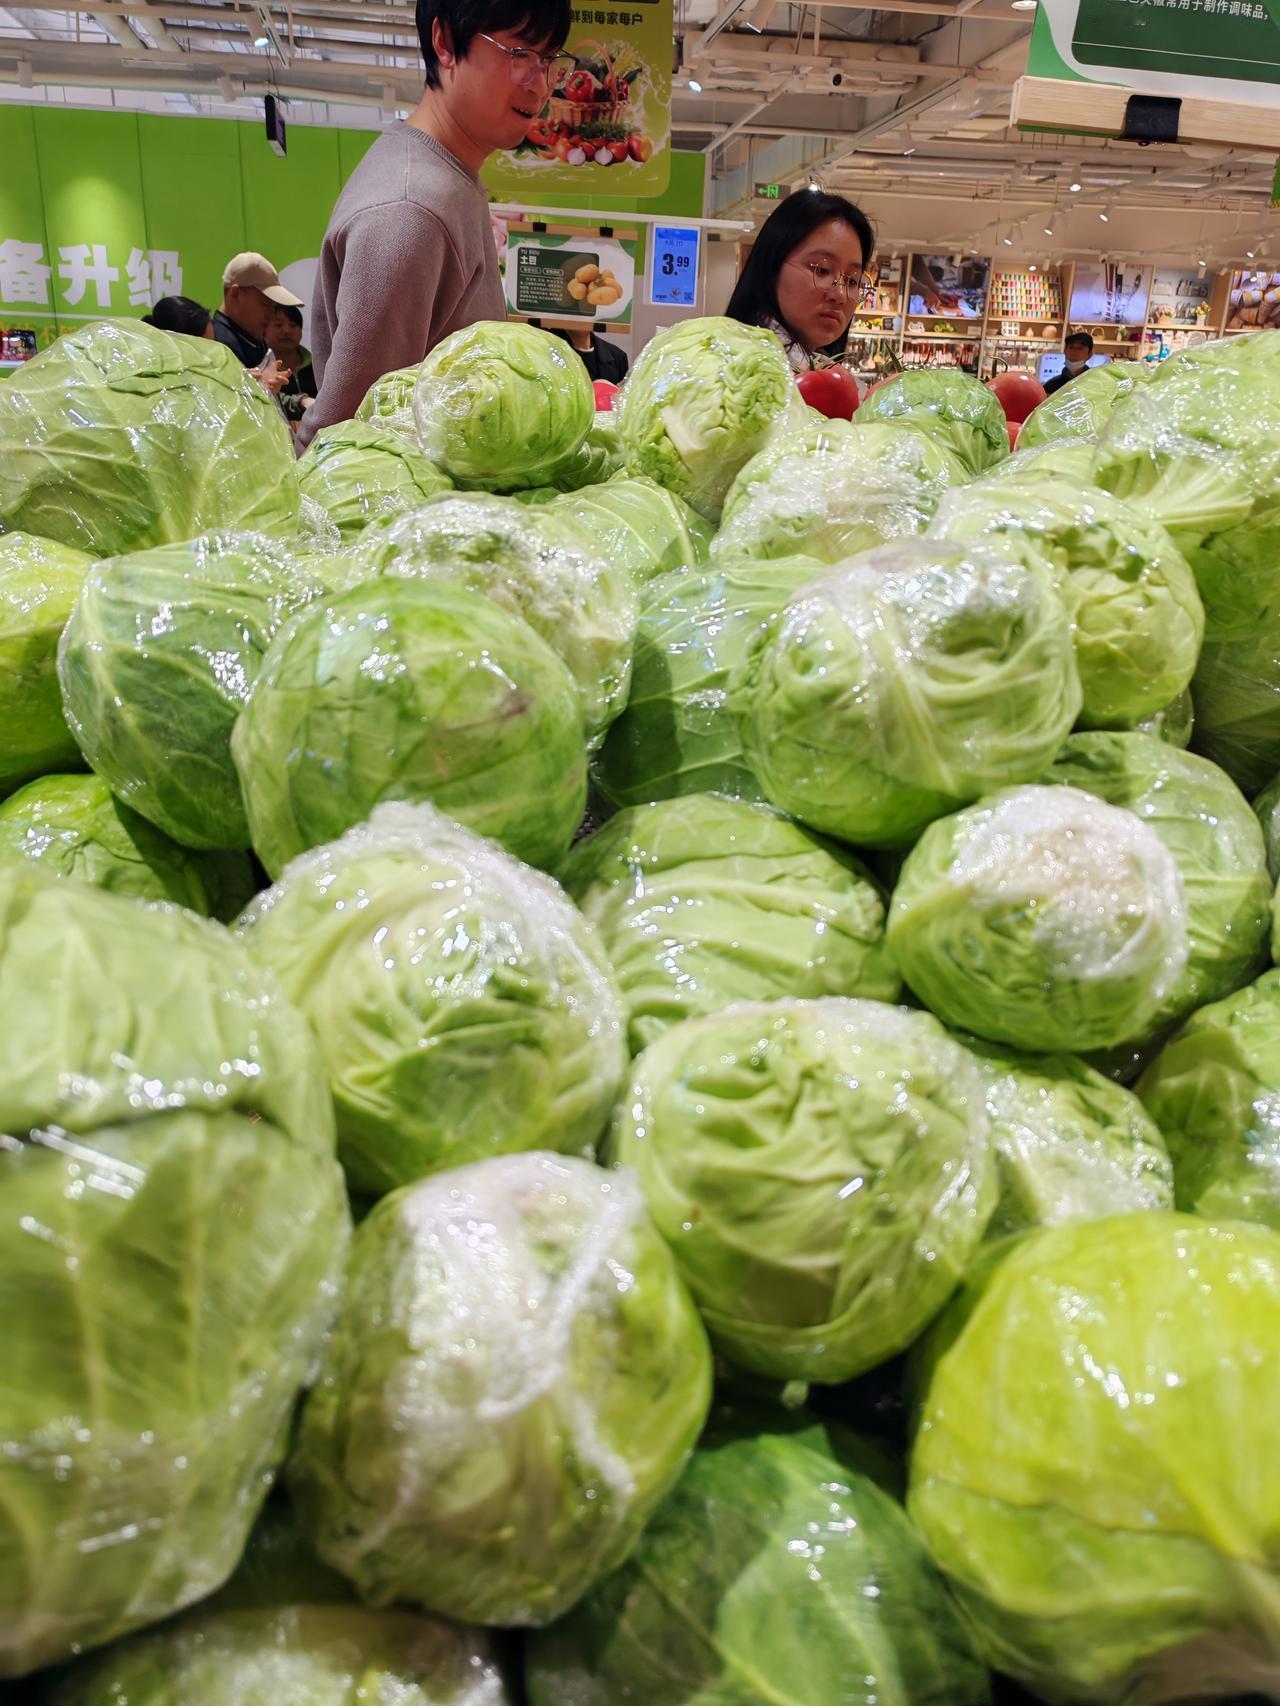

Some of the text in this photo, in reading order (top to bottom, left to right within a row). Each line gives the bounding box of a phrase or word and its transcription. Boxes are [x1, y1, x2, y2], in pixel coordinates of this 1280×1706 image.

[519, 255, 537, 266] 土豆
[662, 253, 690, 276] 3.99
[0, 238, 184, 308] 备升级
